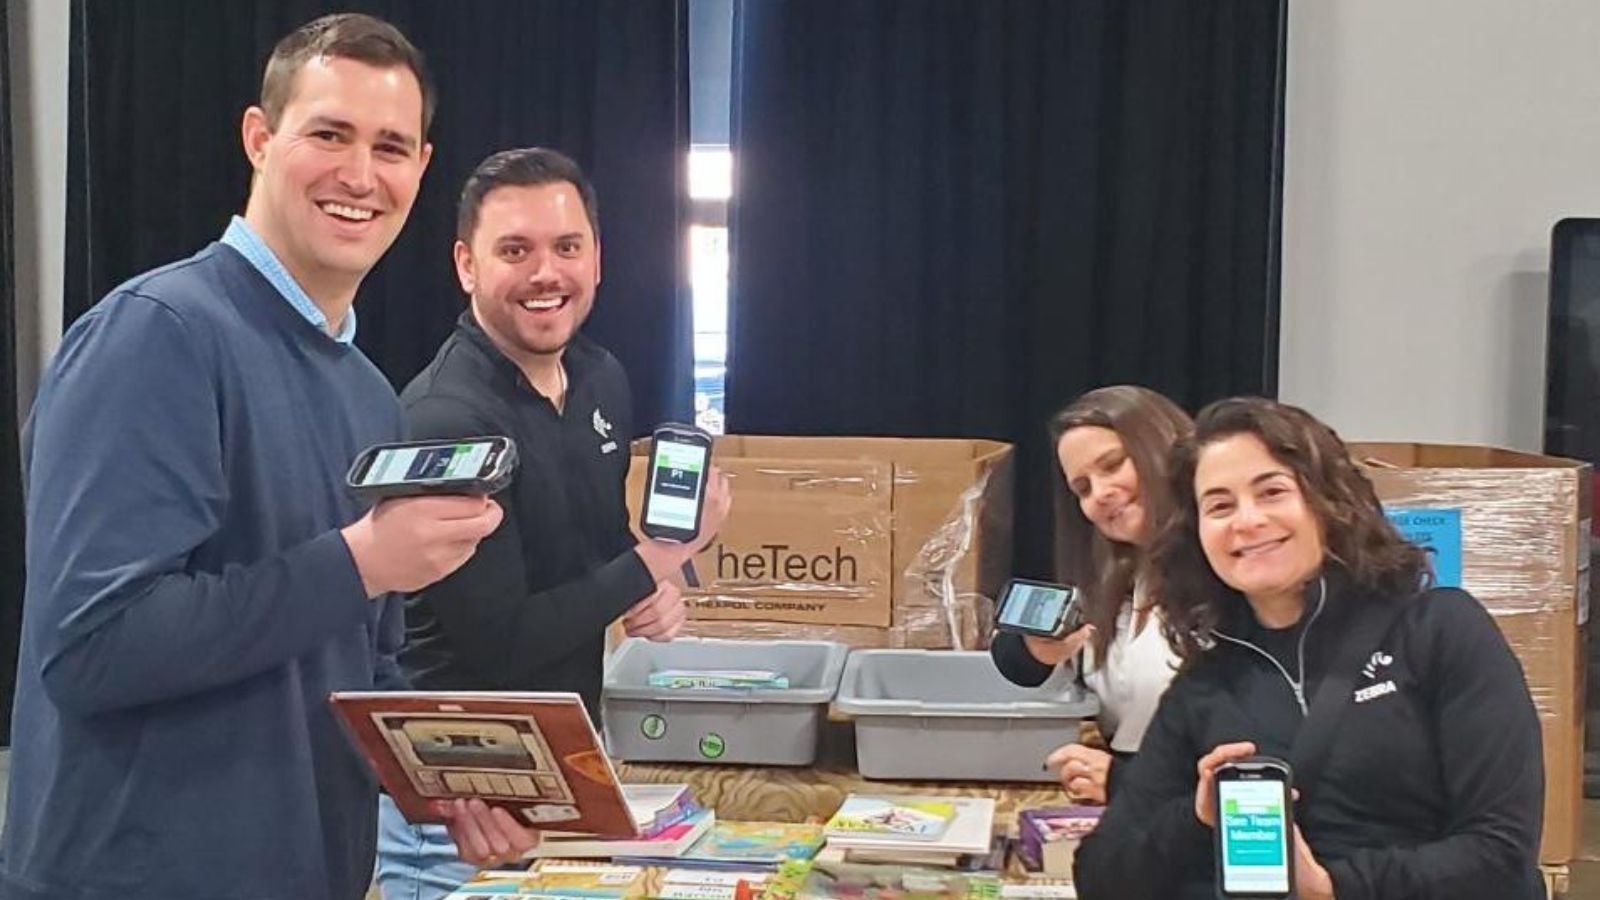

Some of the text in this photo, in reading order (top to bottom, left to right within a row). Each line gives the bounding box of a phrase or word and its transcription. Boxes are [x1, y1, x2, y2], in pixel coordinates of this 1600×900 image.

[681, 544, 857, 588] heTech
[753, 602, 826, 612] COMPANY
[1354, 680, 1398, 703] ZEBRA
